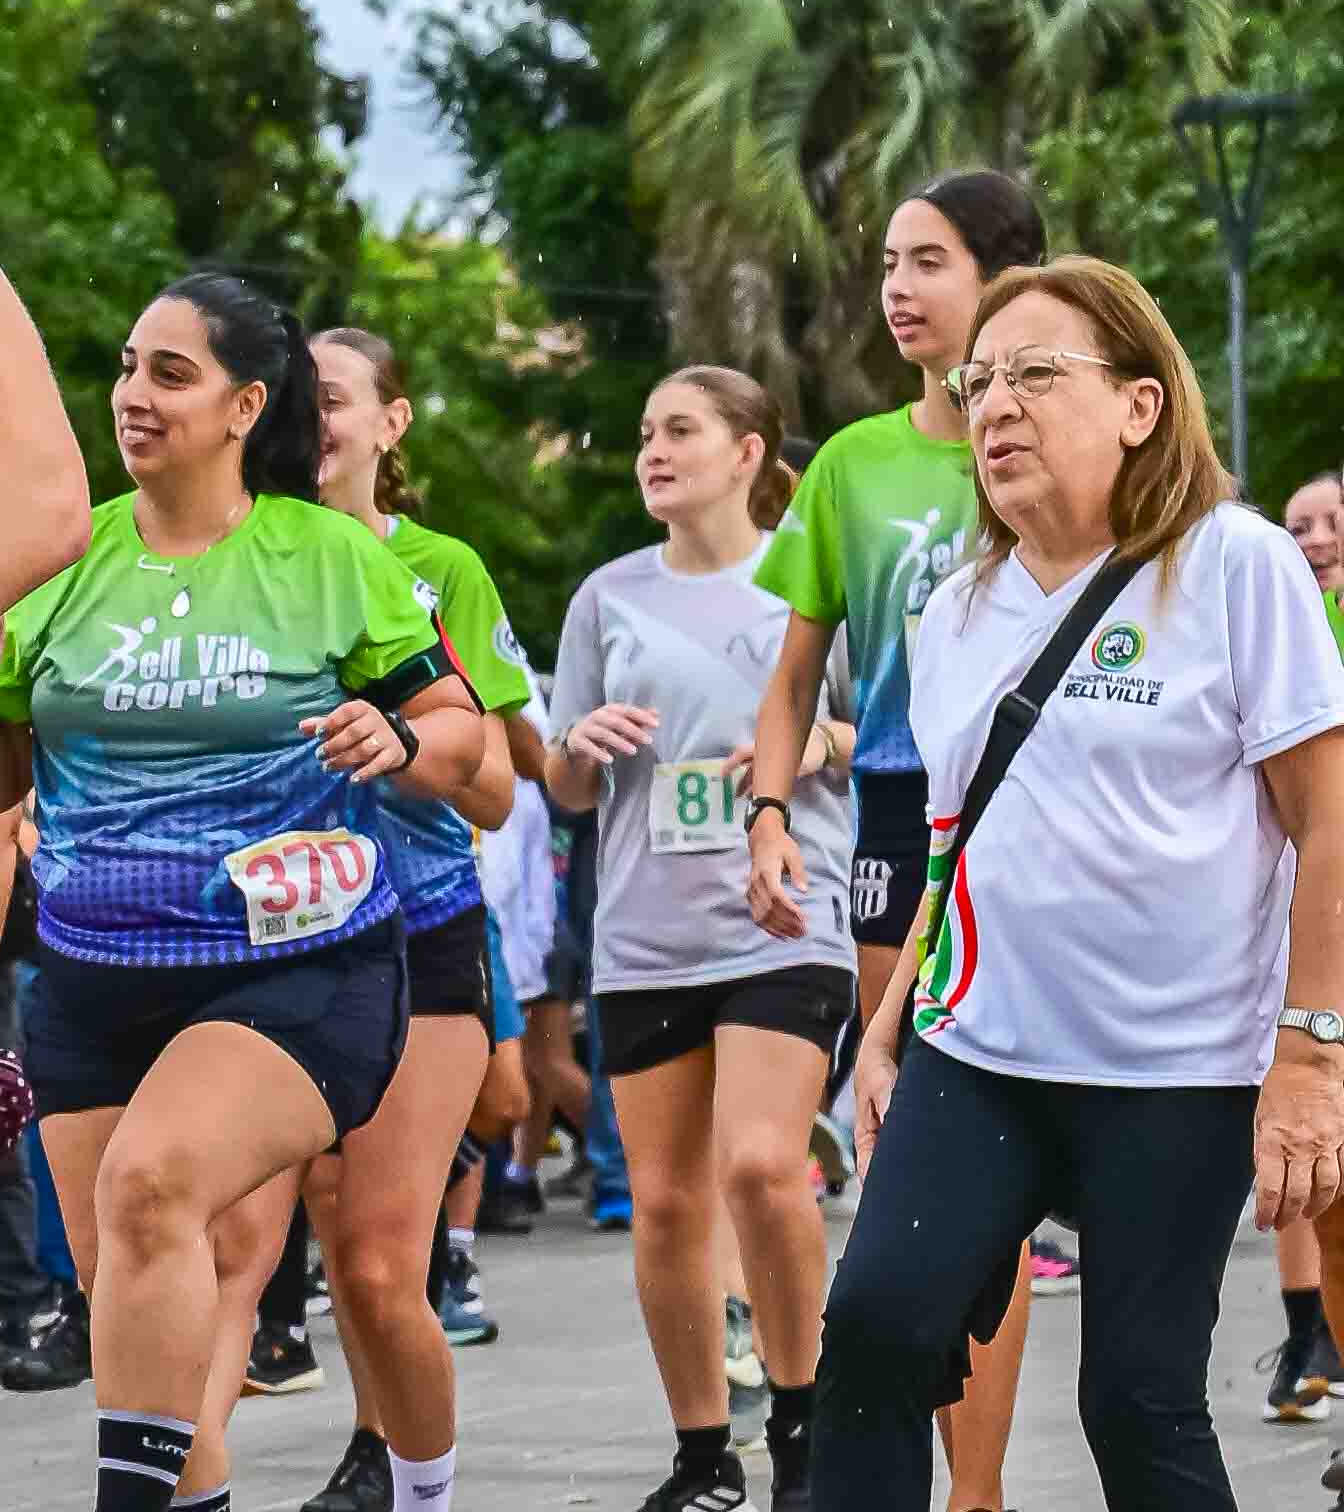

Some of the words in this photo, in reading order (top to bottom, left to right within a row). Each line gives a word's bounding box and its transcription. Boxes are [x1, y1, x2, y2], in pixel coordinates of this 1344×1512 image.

[1063, 683, 1100, 700] BELL
[1105, 684, 1161, 706] VILLE
[245, 839, 367, 913] 370
